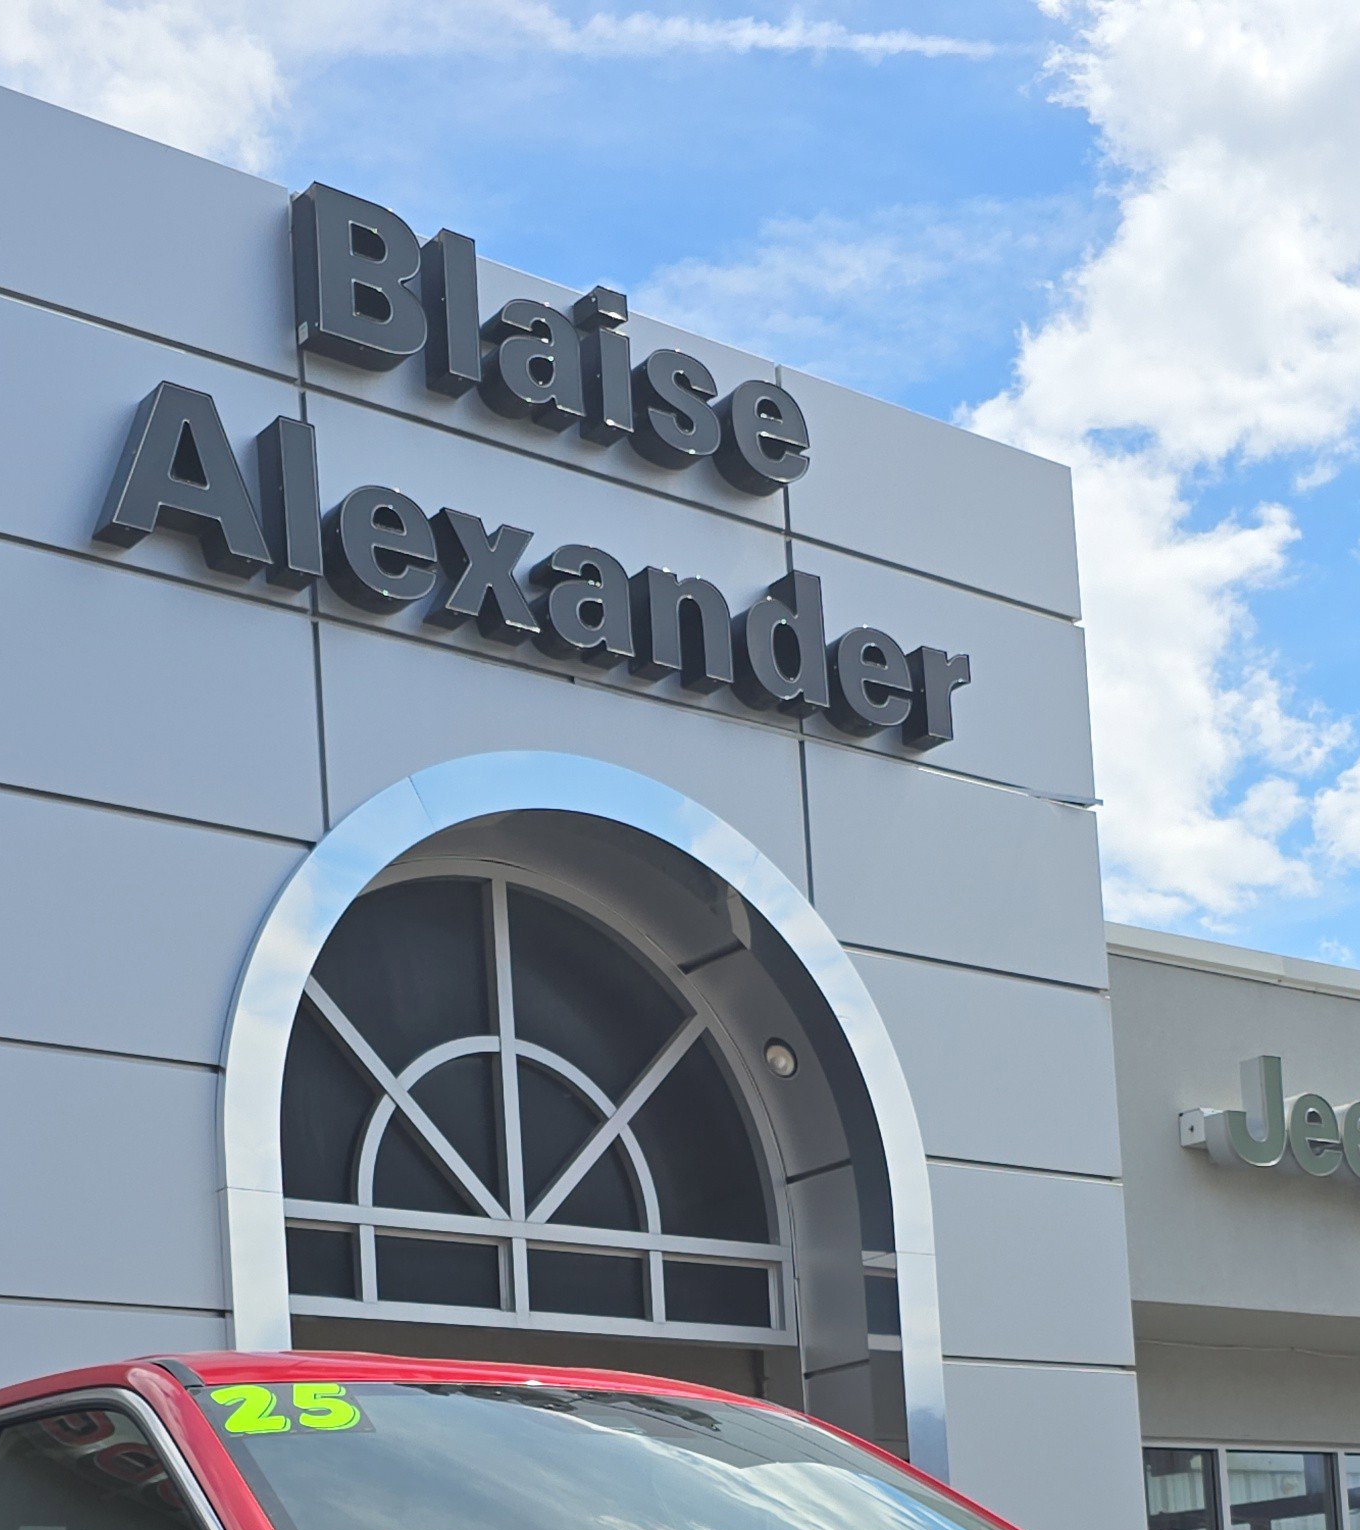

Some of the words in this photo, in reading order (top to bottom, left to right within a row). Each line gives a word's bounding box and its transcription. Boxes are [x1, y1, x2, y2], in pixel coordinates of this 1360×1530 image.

[292, 182, 810, 496] Blaise
[92, 380, 971, 752] Alexander
[209, 1382, 361, 1434] 25
